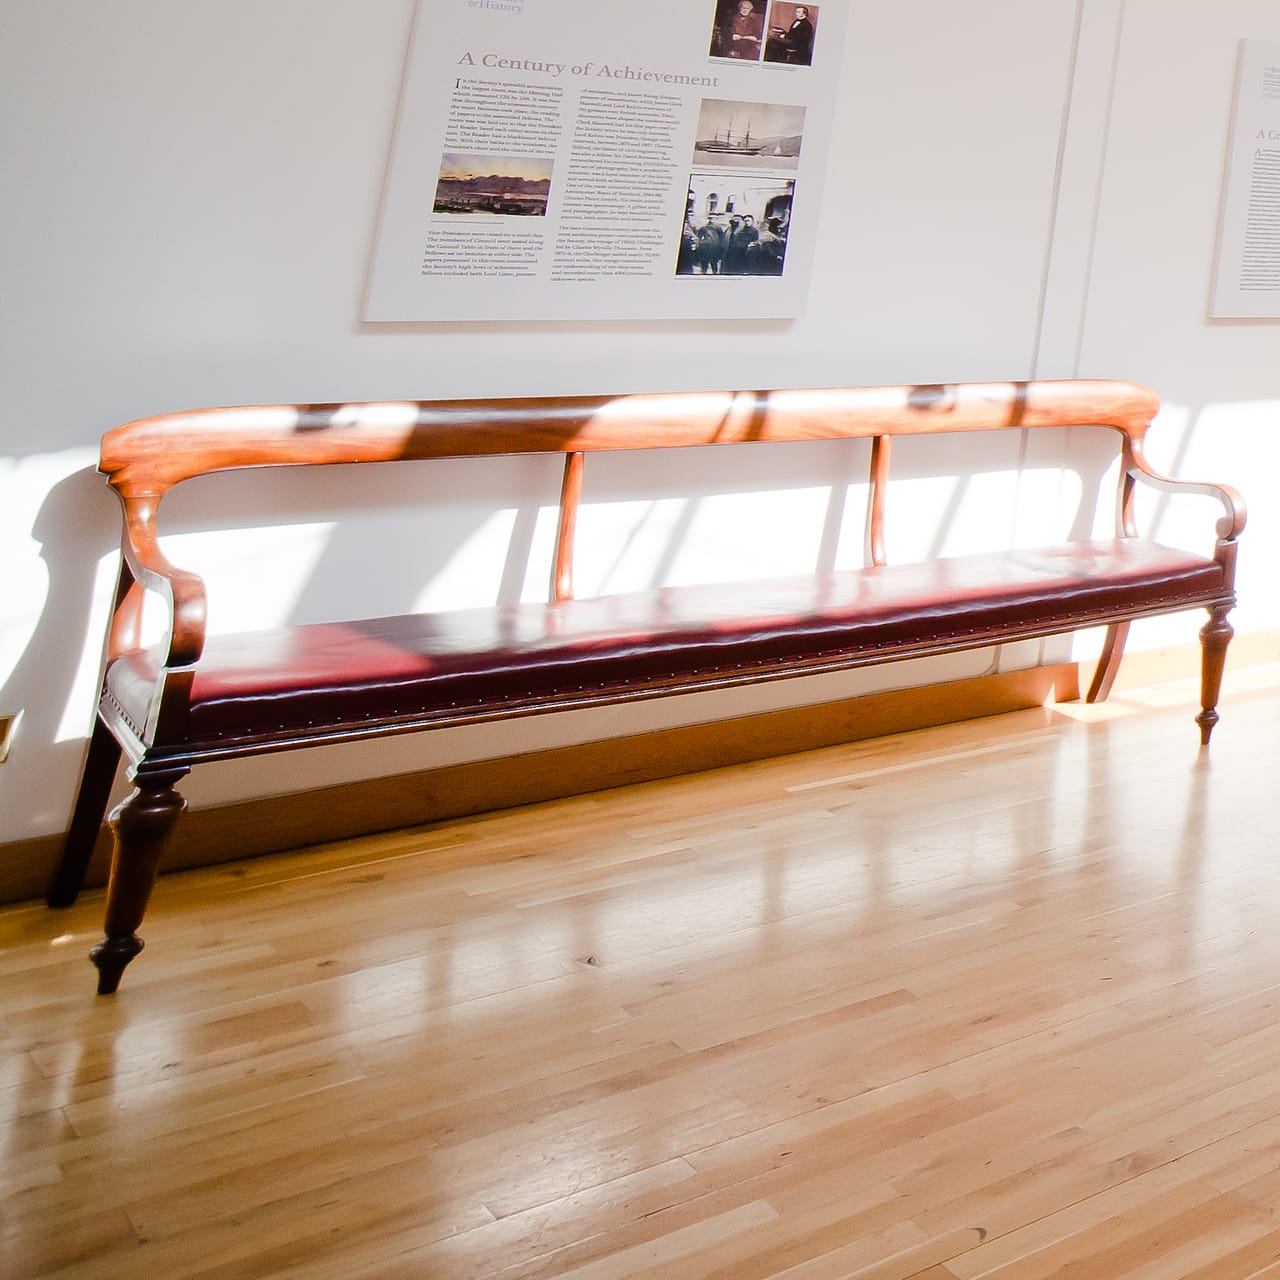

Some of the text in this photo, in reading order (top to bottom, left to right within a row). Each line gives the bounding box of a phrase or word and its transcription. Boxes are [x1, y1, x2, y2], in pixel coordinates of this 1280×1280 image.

[480, 0, 523, 15] History
[457, 51, 719, 88] A Century of Achievement
